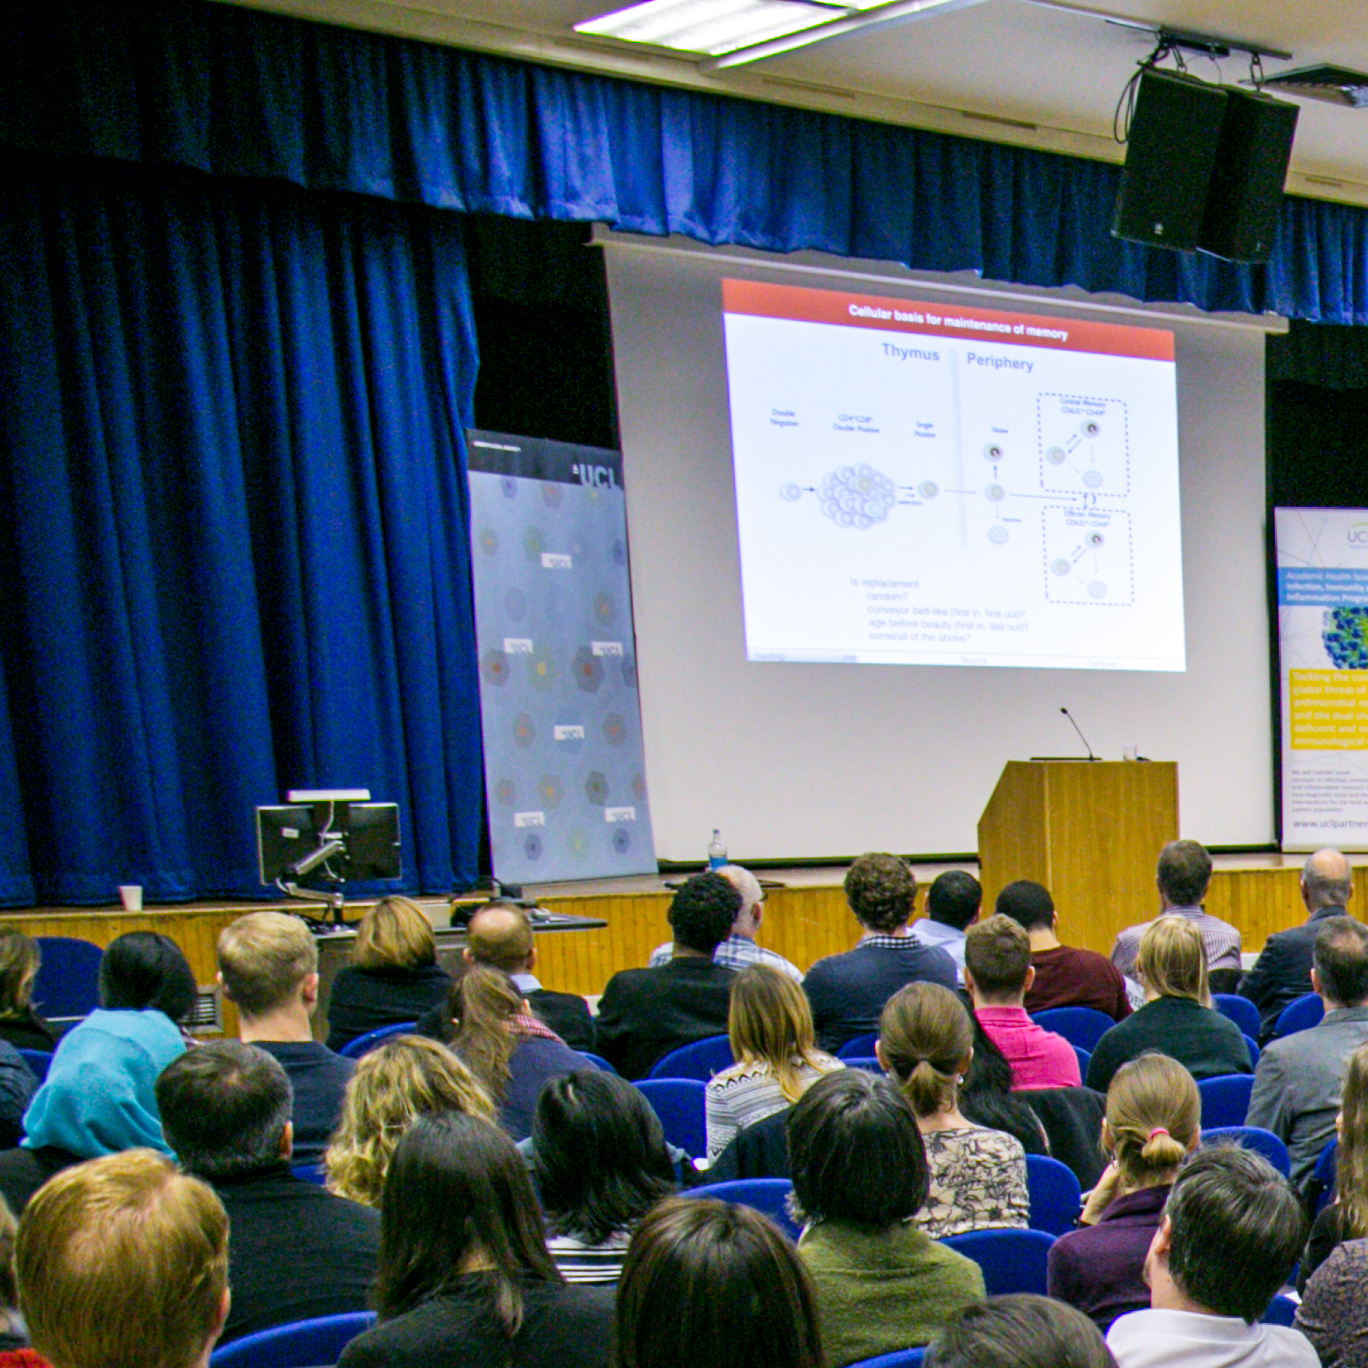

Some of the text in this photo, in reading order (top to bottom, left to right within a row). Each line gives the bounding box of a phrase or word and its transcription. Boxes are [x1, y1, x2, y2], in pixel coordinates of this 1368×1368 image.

[848, 303, 1068, 342] Cellular basis for maintenance of memory
[881, 343, 940, 361] Thymus
[967, 352, 1034, 373] Periphery
[579, 464, 621, 491] UCL
[1286, 572, 1324, 581] Academic
[1325, 572, 1352, 581] Health
[850, 577, 919, 589] Is replacement
[1286, 582, 1324, 592] Infection,
[1325, 583, 1365, 593] Immunity
[867, 592, 908, 601] random?
[1286, 592, 1340, 602] Inflammation
[868, 606, 910, 616] conveyor
[912, 606, 948, 617] belt-like
[950, 607, 970, 618] (first
[985, 608, 1002, 618] first
[1004, 609, 1026, 620] out)?
[868, 619, 887, 628] age
[889, 618, 918, 629] before
[921, 619, 952, 631] beauty
[954, 620, 974, 631] (first
[989, 622, 1004, 631] last
[1007, 622, 1029, 633] out)?
[869, 631, 971, 643] some/all of the above?
[1292, 672, 1331, 684] Tackling
[1332, 672, 1349, 683] the
[1292, 685, 1323, 696] global
[1323, 685, 1354, 695] threat
[1356, 685, 1367, 695] of
[1293, 698, 1356, 708] antimicrobial
[1293, 711, 1312, 720] and
[1313, 711, 1330, 721] the
[1332, 711, 1354, 721] dual
[1294, 724, 1336, 733] deficient
[1337, 724, 1356, 733] and
[1294, 737, 1365, 748] immunological
